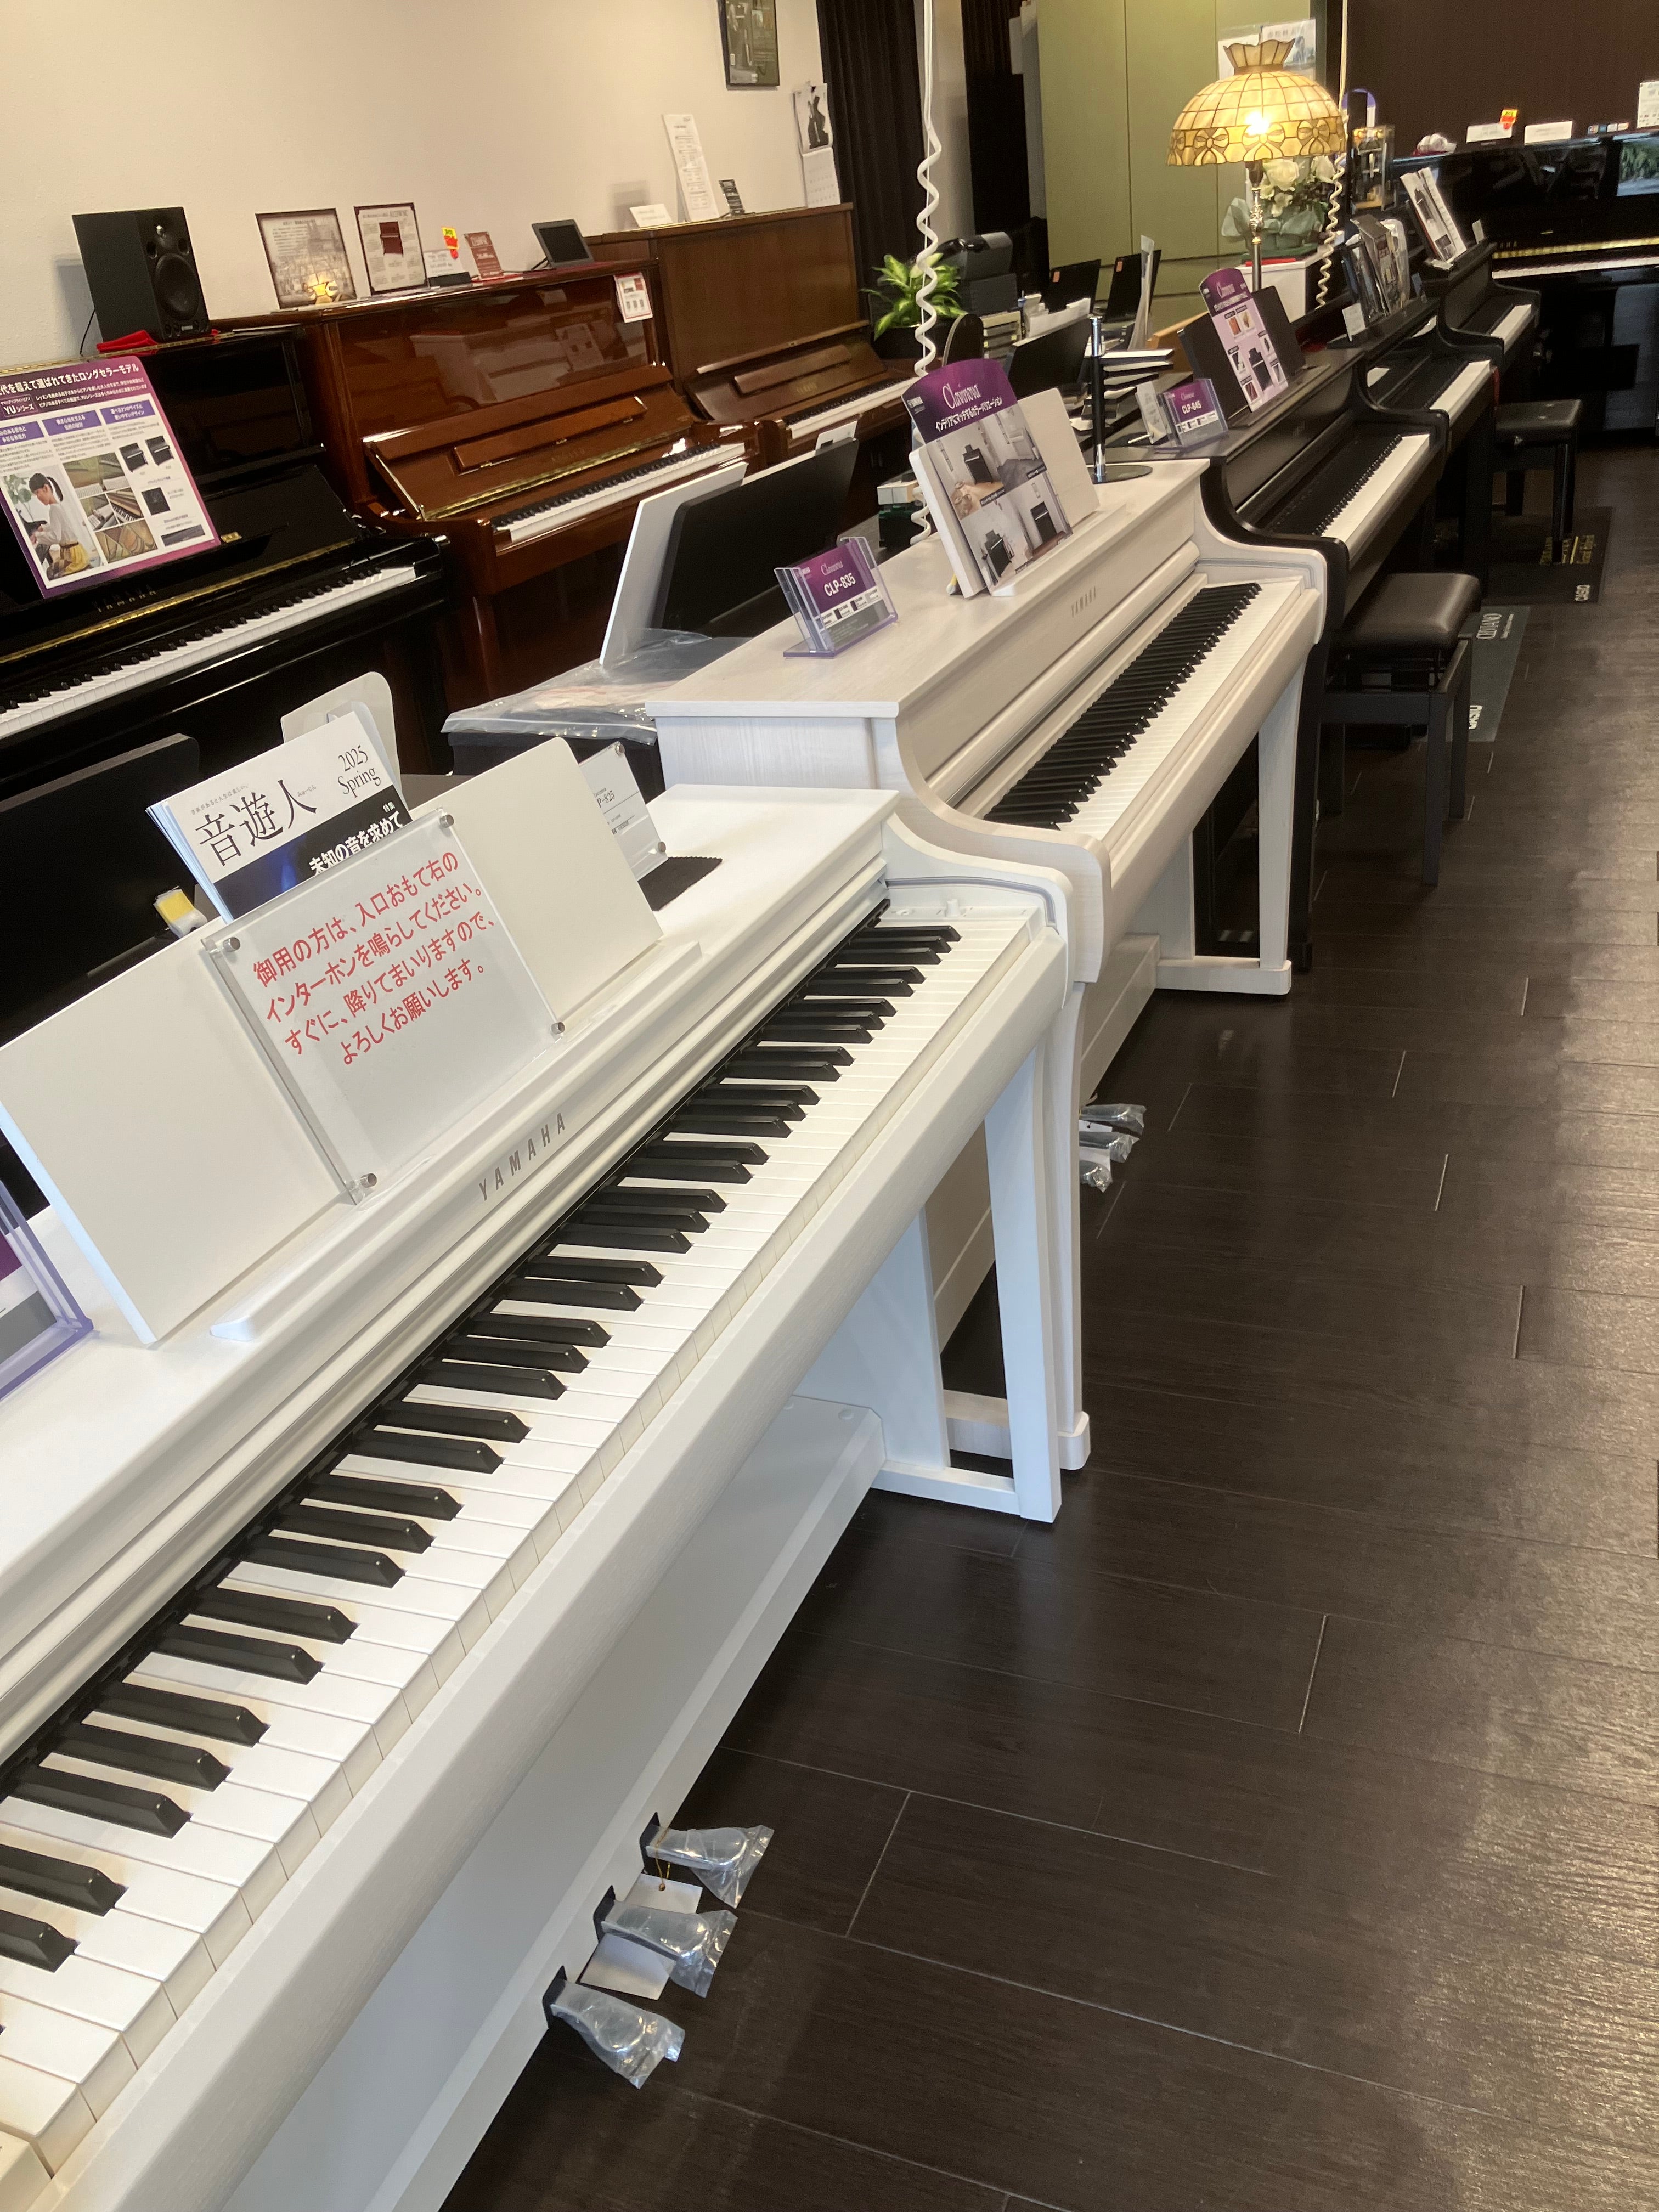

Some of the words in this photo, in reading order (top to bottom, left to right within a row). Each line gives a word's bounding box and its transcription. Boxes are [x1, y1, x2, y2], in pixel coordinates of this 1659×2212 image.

[0, 363, 139, 395] 代を超えて選ばれてきたロングセラーモデル
[943, 383, 981, 409] Clavinova
[3, 403, 35, 415] YUシリーズ
[824, 572, 856, 596] CLP-835
[337, 767, 381, 798] Spring
[338, 745, 368, 772] 2025
[195, 779, 317, 866] 音遊人
[383, 801, 396, 812] 特集
[309, 810, 403, 876] 未知の音を求めて
[253, 852, 458, 987] 御用の方は、入口おもて右の
[267, 883, 481, 1023] インターホンを鳴らしてください。
[285, 911, 494, 1054] すぐに、降りてまいりますので、
[341, 958, 483, 1065] よろしくお願いします。
[479, 1113, 565, 1201] YAMAHA
